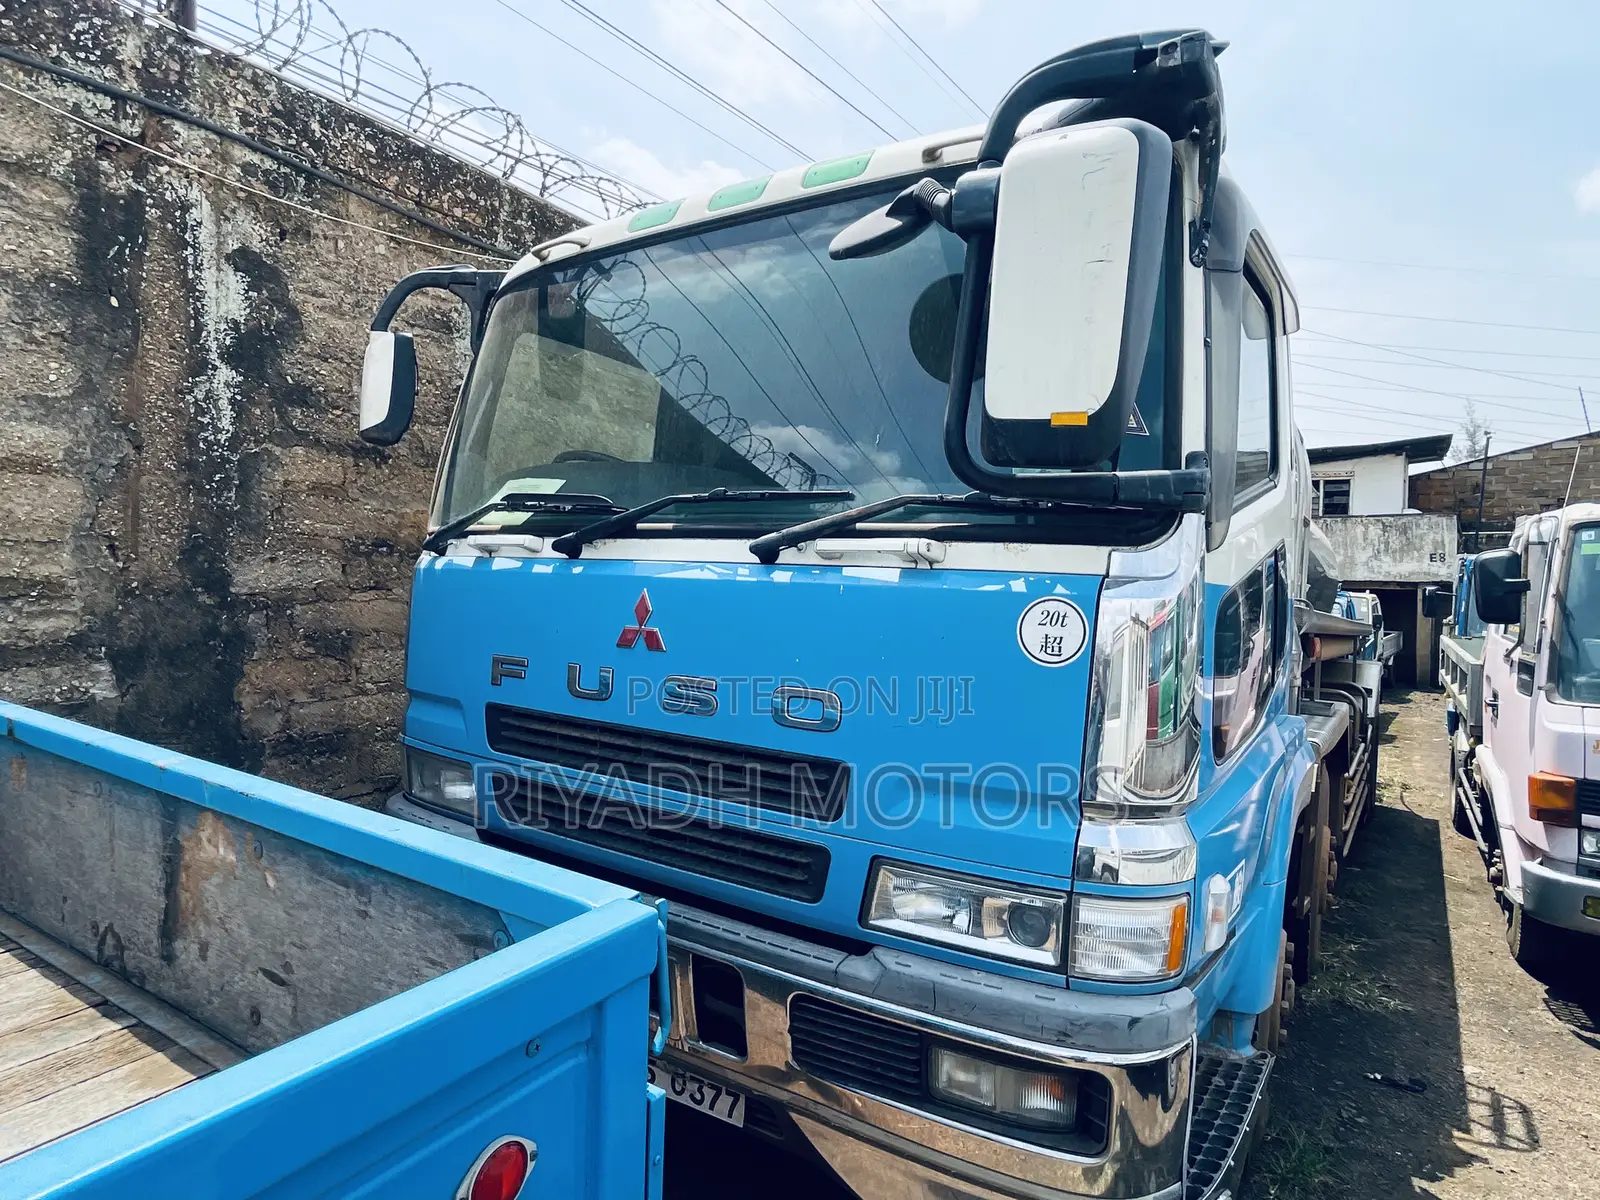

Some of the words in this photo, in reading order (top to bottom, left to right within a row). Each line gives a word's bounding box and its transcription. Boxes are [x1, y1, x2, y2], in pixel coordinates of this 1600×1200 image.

[1429, 552, 1446, 563] E8
[1038, 609, 1069, 628] 20t
[1039, 633, 1064, 657] 超
[491, 654, 842, 732] FUSO
